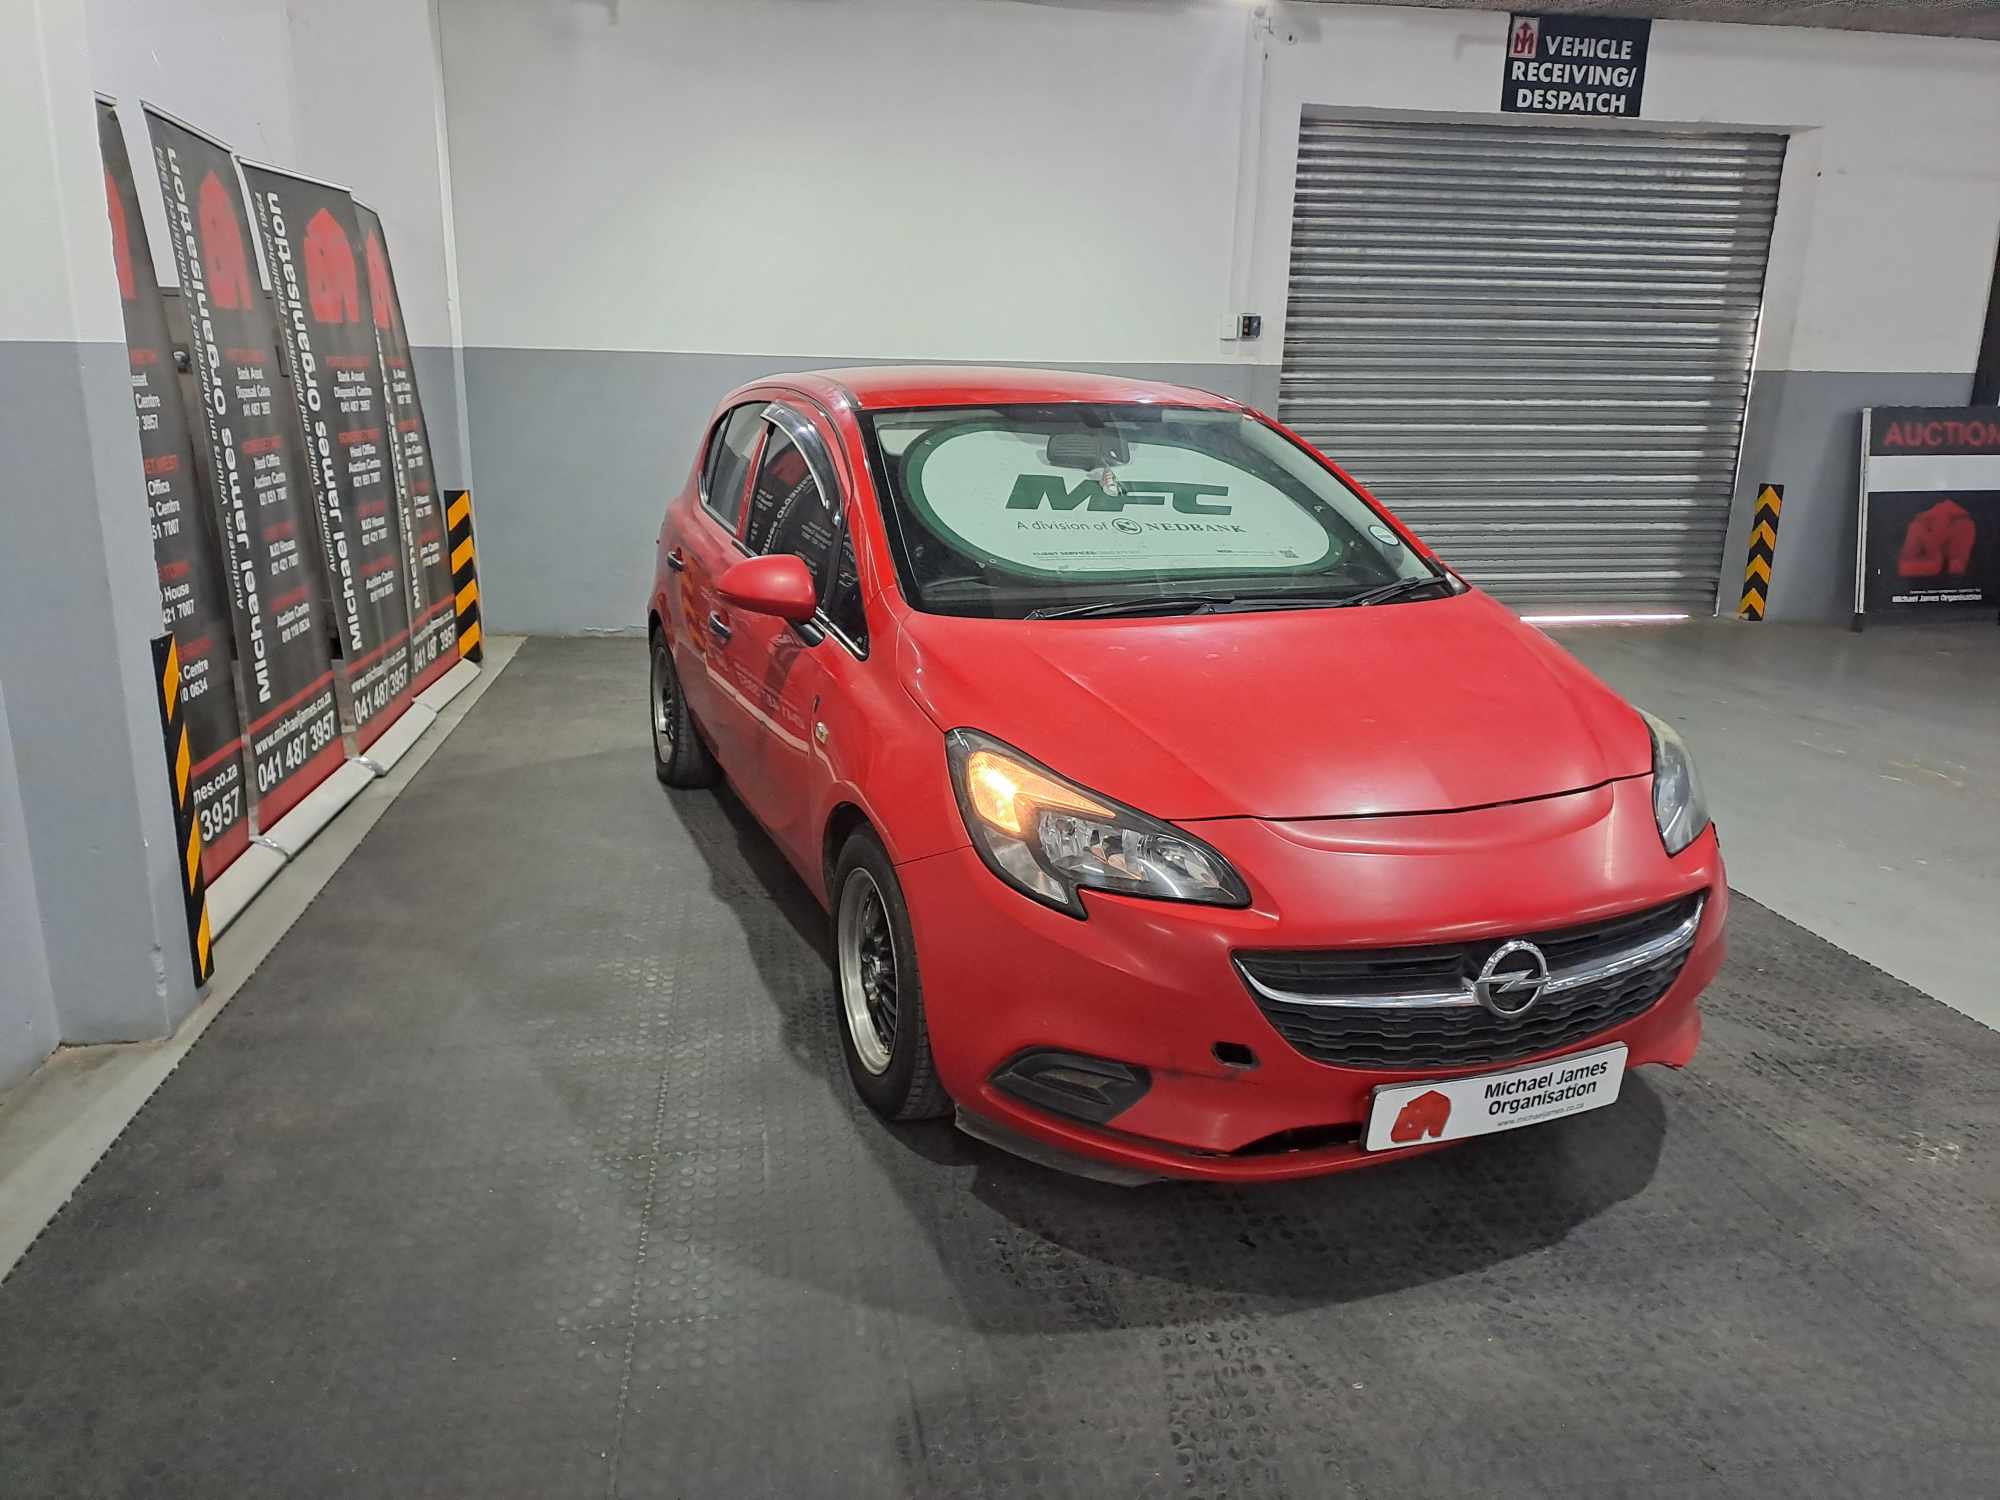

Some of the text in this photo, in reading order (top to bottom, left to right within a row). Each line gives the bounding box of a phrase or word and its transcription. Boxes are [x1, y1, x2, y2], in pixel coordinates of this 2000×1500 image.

[1545, 36, 1633, 60] VEHICLE
[1511, 60, 1637, 88] RECEIVING/
[1516, 88, 1626, 113] DESPATCH
[167, 147, 271, 704] Michael James Organisation
[206, 407, 218, 440] and
[267, 192, 363, 651] Michael James Organisation
[299, 404, 311, 432] and
[1884, 420, 2000, 447] AUCTION
[213, 445, 228, 505] Valuers
[305, 435, 321, 486] Valuers
[148, 479, 170, 496] Office
[1005, 474, 1232, 515] MFC
[156, 500, 180, 516] Centre
[151, 523, 162, 539] 51
[1017, 520, 1248, 533] A division of NEDBANK
[163, 584, 189, 602] House
[177, 600, 195, 619] 7007
[183, 658, 209, 680] Centre
[355, 662, 408, 725] 041 487 3957
[254, 691, 332, 756] www.michaeljames.co.za
[258, 709, 335, 793] 041 487 3957
[201, 786, 240, 842] 3957
[1484, 1061, 1608, 1099] Michael James
[1488, 1081, 1597, 1115] Organisation
